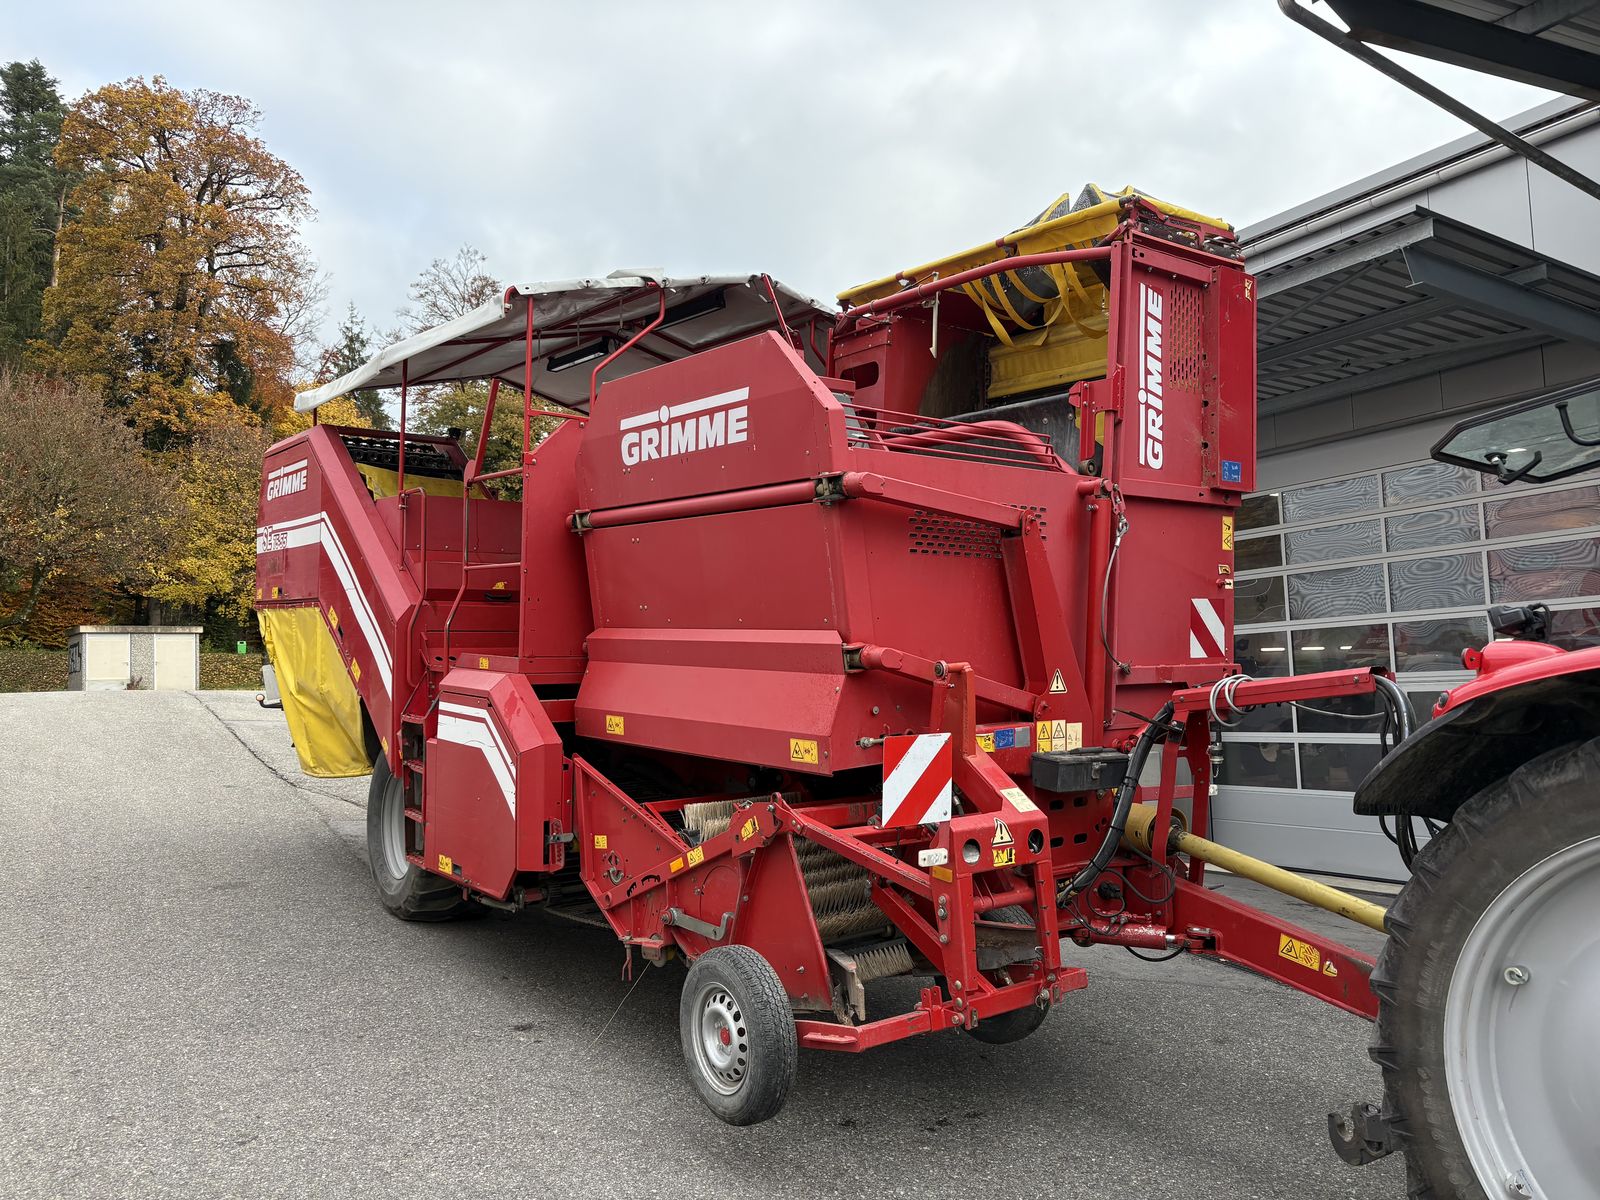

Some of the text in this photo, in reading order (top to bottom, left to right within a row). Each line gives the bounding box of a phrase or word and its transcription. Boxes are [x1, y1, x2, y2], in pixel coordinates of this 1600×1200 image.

[1138, 287, 1164, 470] GRIMME
[620, 404, 748, 466] GRIMME
[267, 466, 308, 501] GRIMME
